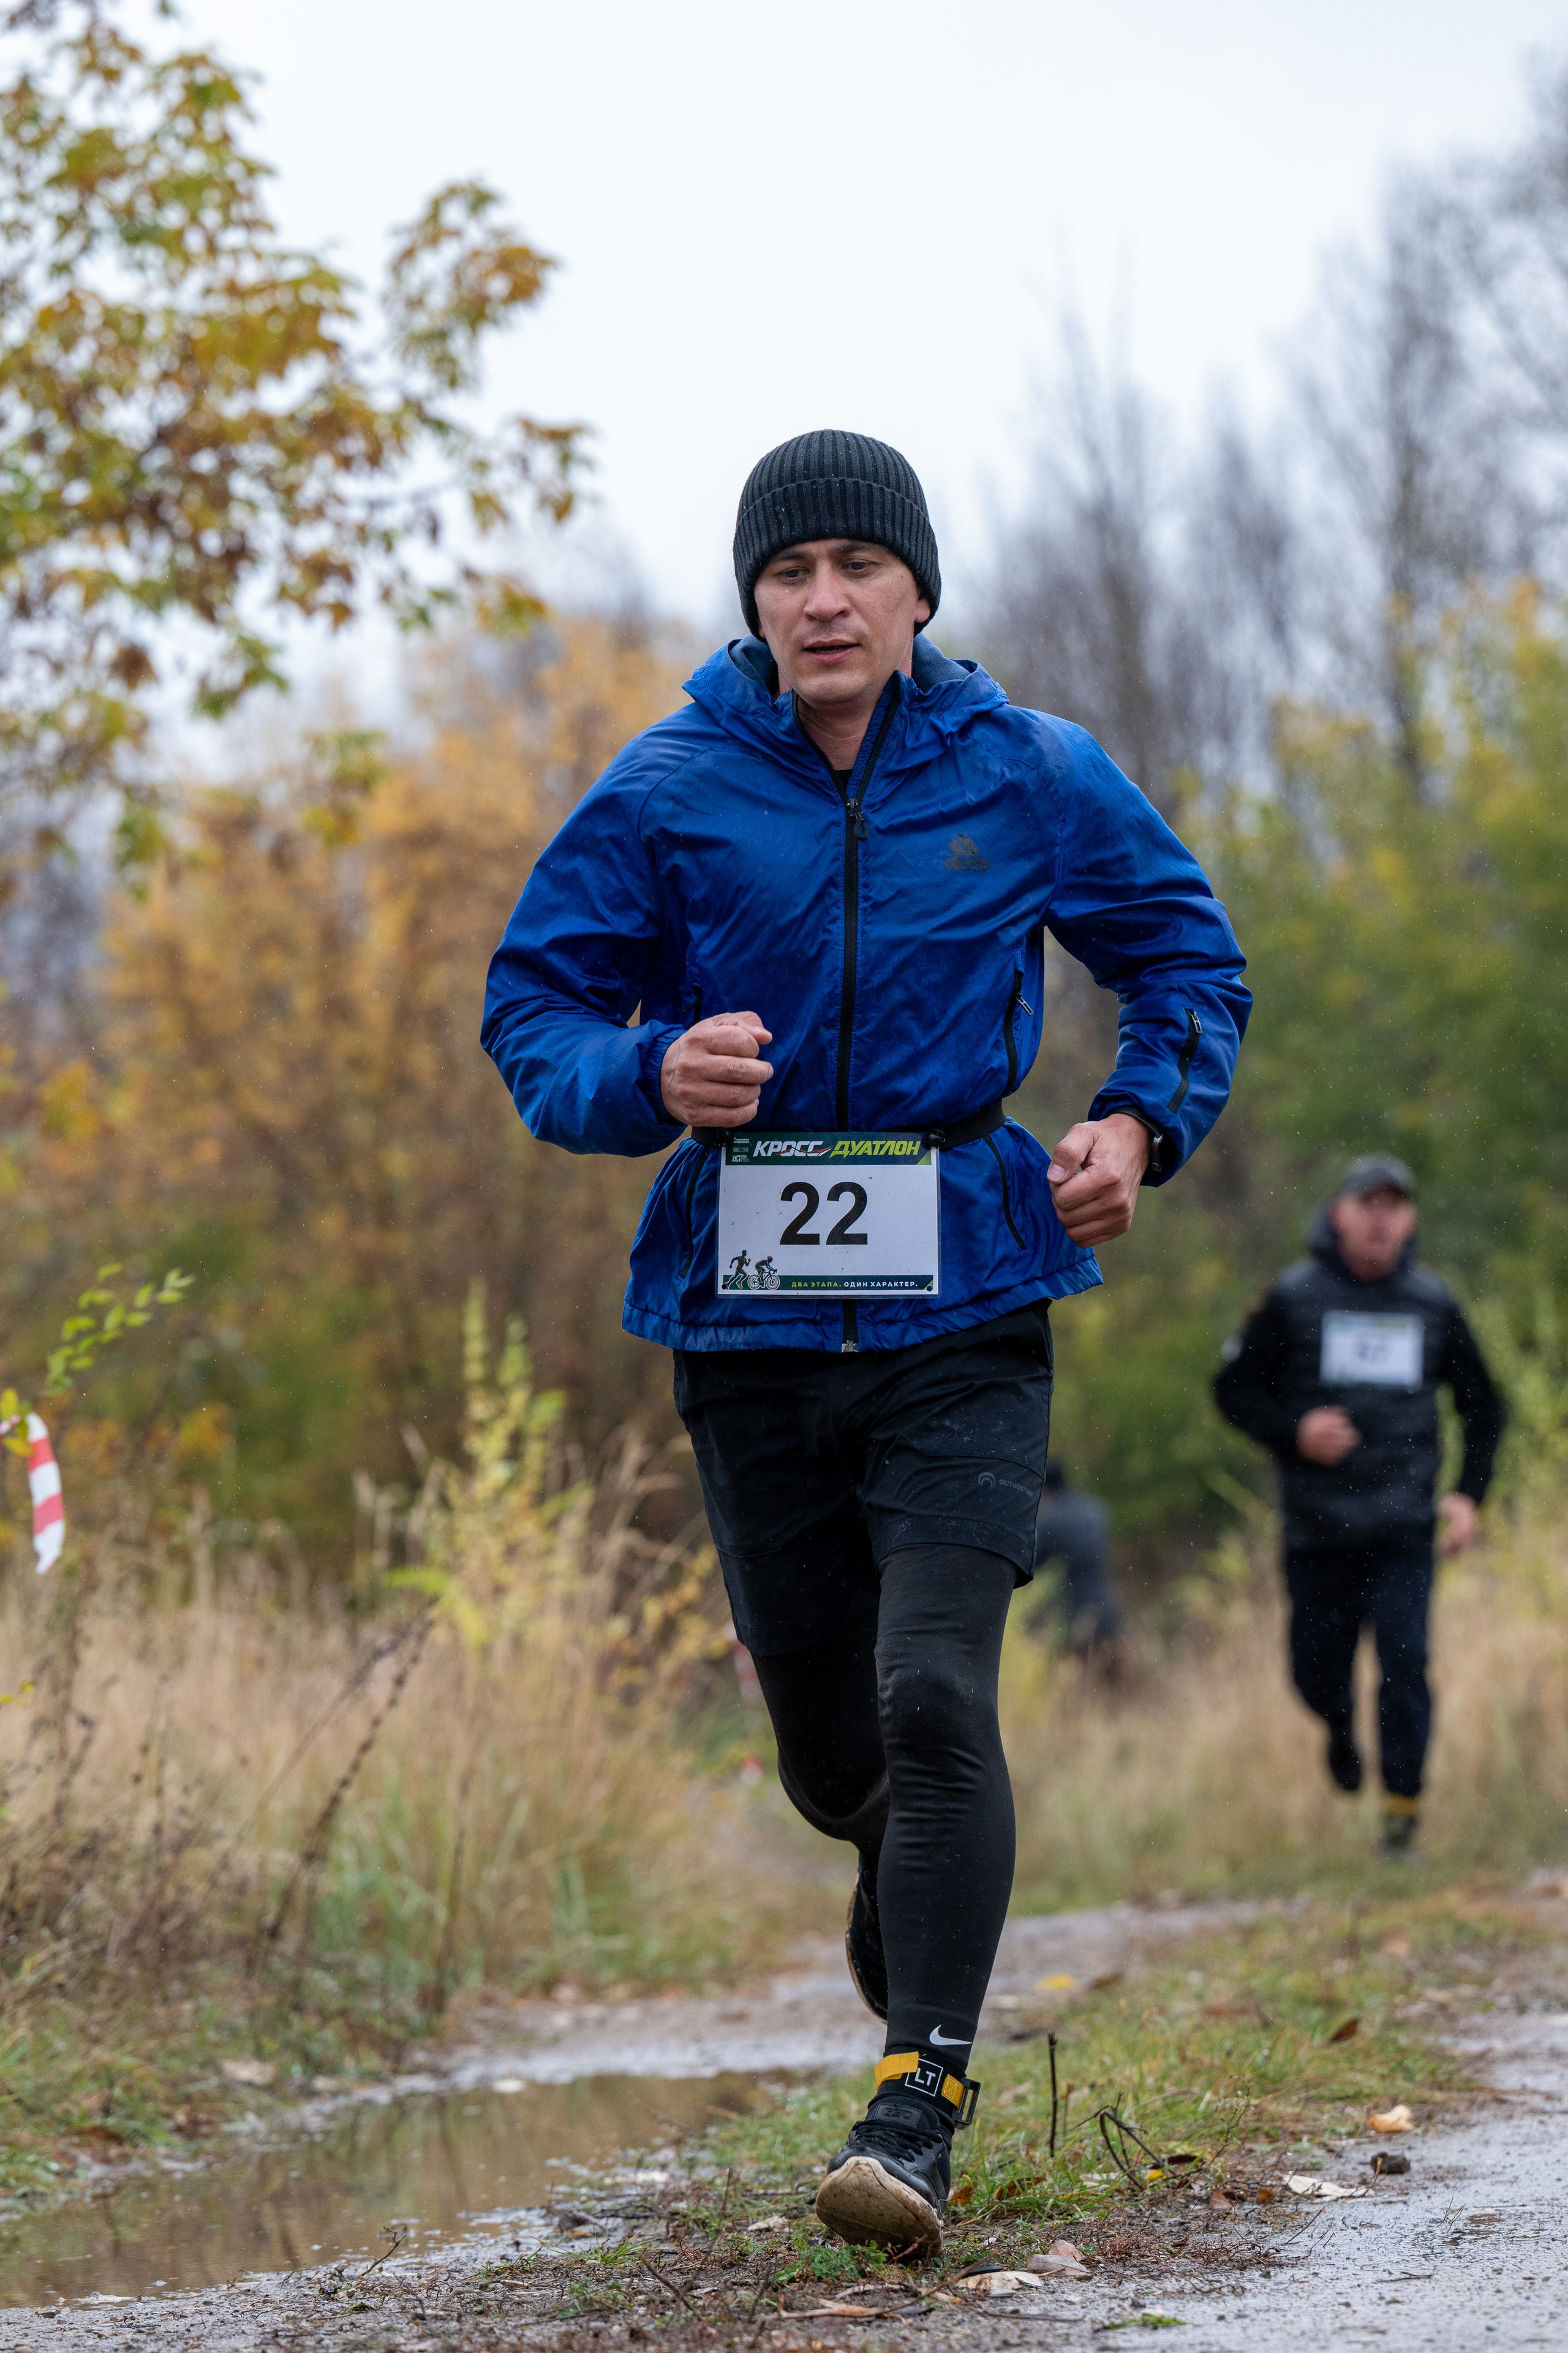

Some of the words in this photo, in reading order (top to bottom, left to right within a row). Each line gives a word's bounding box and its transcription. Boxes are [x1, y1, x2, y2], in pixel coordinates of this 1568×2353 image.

[753, 1141, 825, 1157] КРОСС
[829, 1140, 921, 1158] ДУАТЛОН
[780, 1182, 868, 1245] 22
